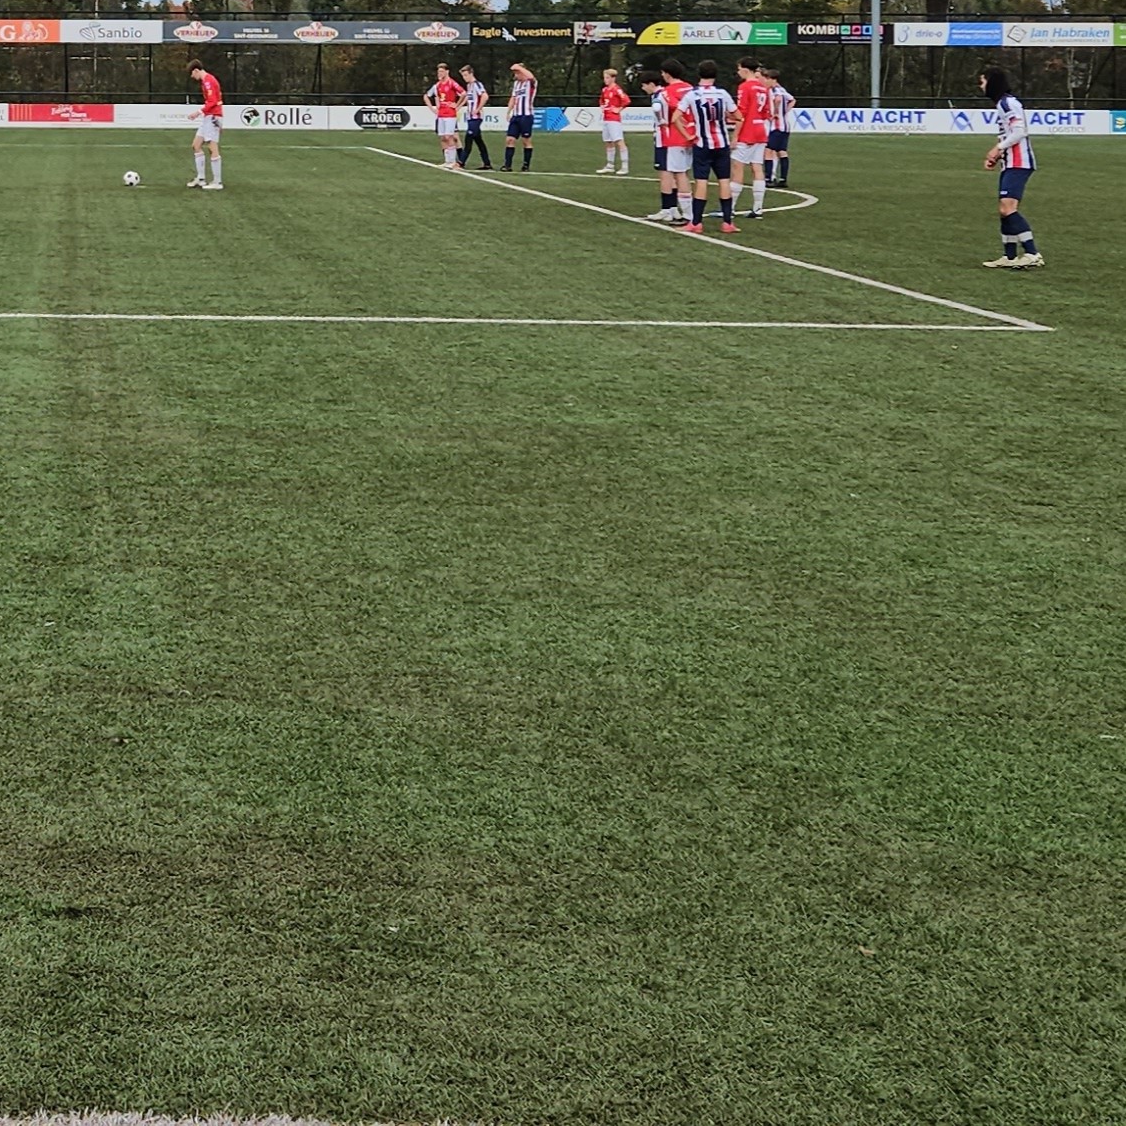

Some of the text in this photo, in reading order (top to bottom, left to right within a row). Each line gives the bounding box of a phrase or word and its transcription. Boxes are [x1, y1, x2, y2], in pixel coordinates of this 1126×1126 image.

[98, 27, 142, 38] Sanbio
[473, 27, 501, 38] Eagle
[683, 30, 714, 38] AARLE
[798, 25, 839, 35] KOMBI
[915, 30, 942, 38] drie-o
[1031, 27, 1110, 38] Jan Habraken
[702, 98, 723, 121] 11
[265, 108, 312, 125] Rollé
[363, 114, 402, 123] KROEG
[824, 111, 926, 123] VAN ACHT
[1031, 113, 1085, 125] ACHT
